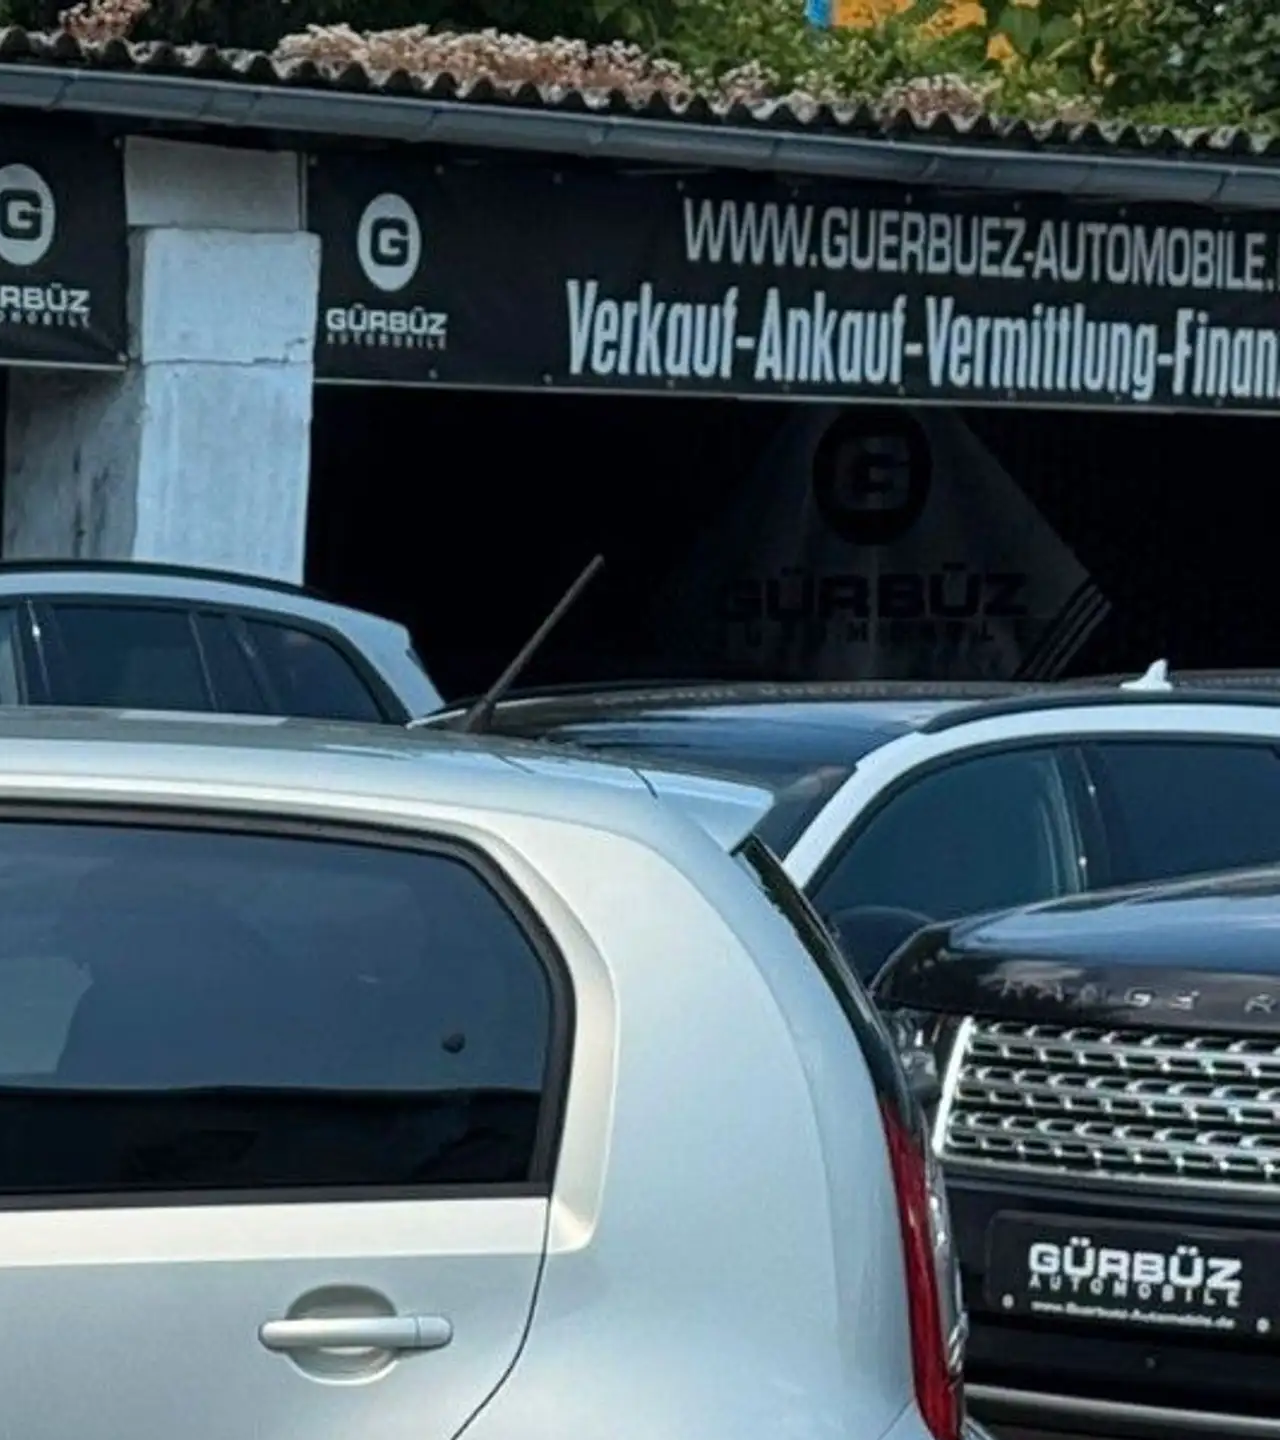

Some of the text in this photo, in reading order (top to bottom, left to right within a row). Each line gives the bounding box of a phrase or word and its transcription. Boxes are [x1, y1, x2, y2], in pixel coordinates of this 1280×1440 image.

[683, 197, 1280, 292] WWW.GUERBUEZ-AUTOMOBILE.
[326, 302, 448, 335] GÜRBÜZ
[567, 279, 1280, 401] Verkauf-Ankauf-Vermittlung-Finan
[1028, 1236, 1242, 1290] GÜRBÜZ
[1029, 1272, 1239, 1308] AUTOMOBILE
